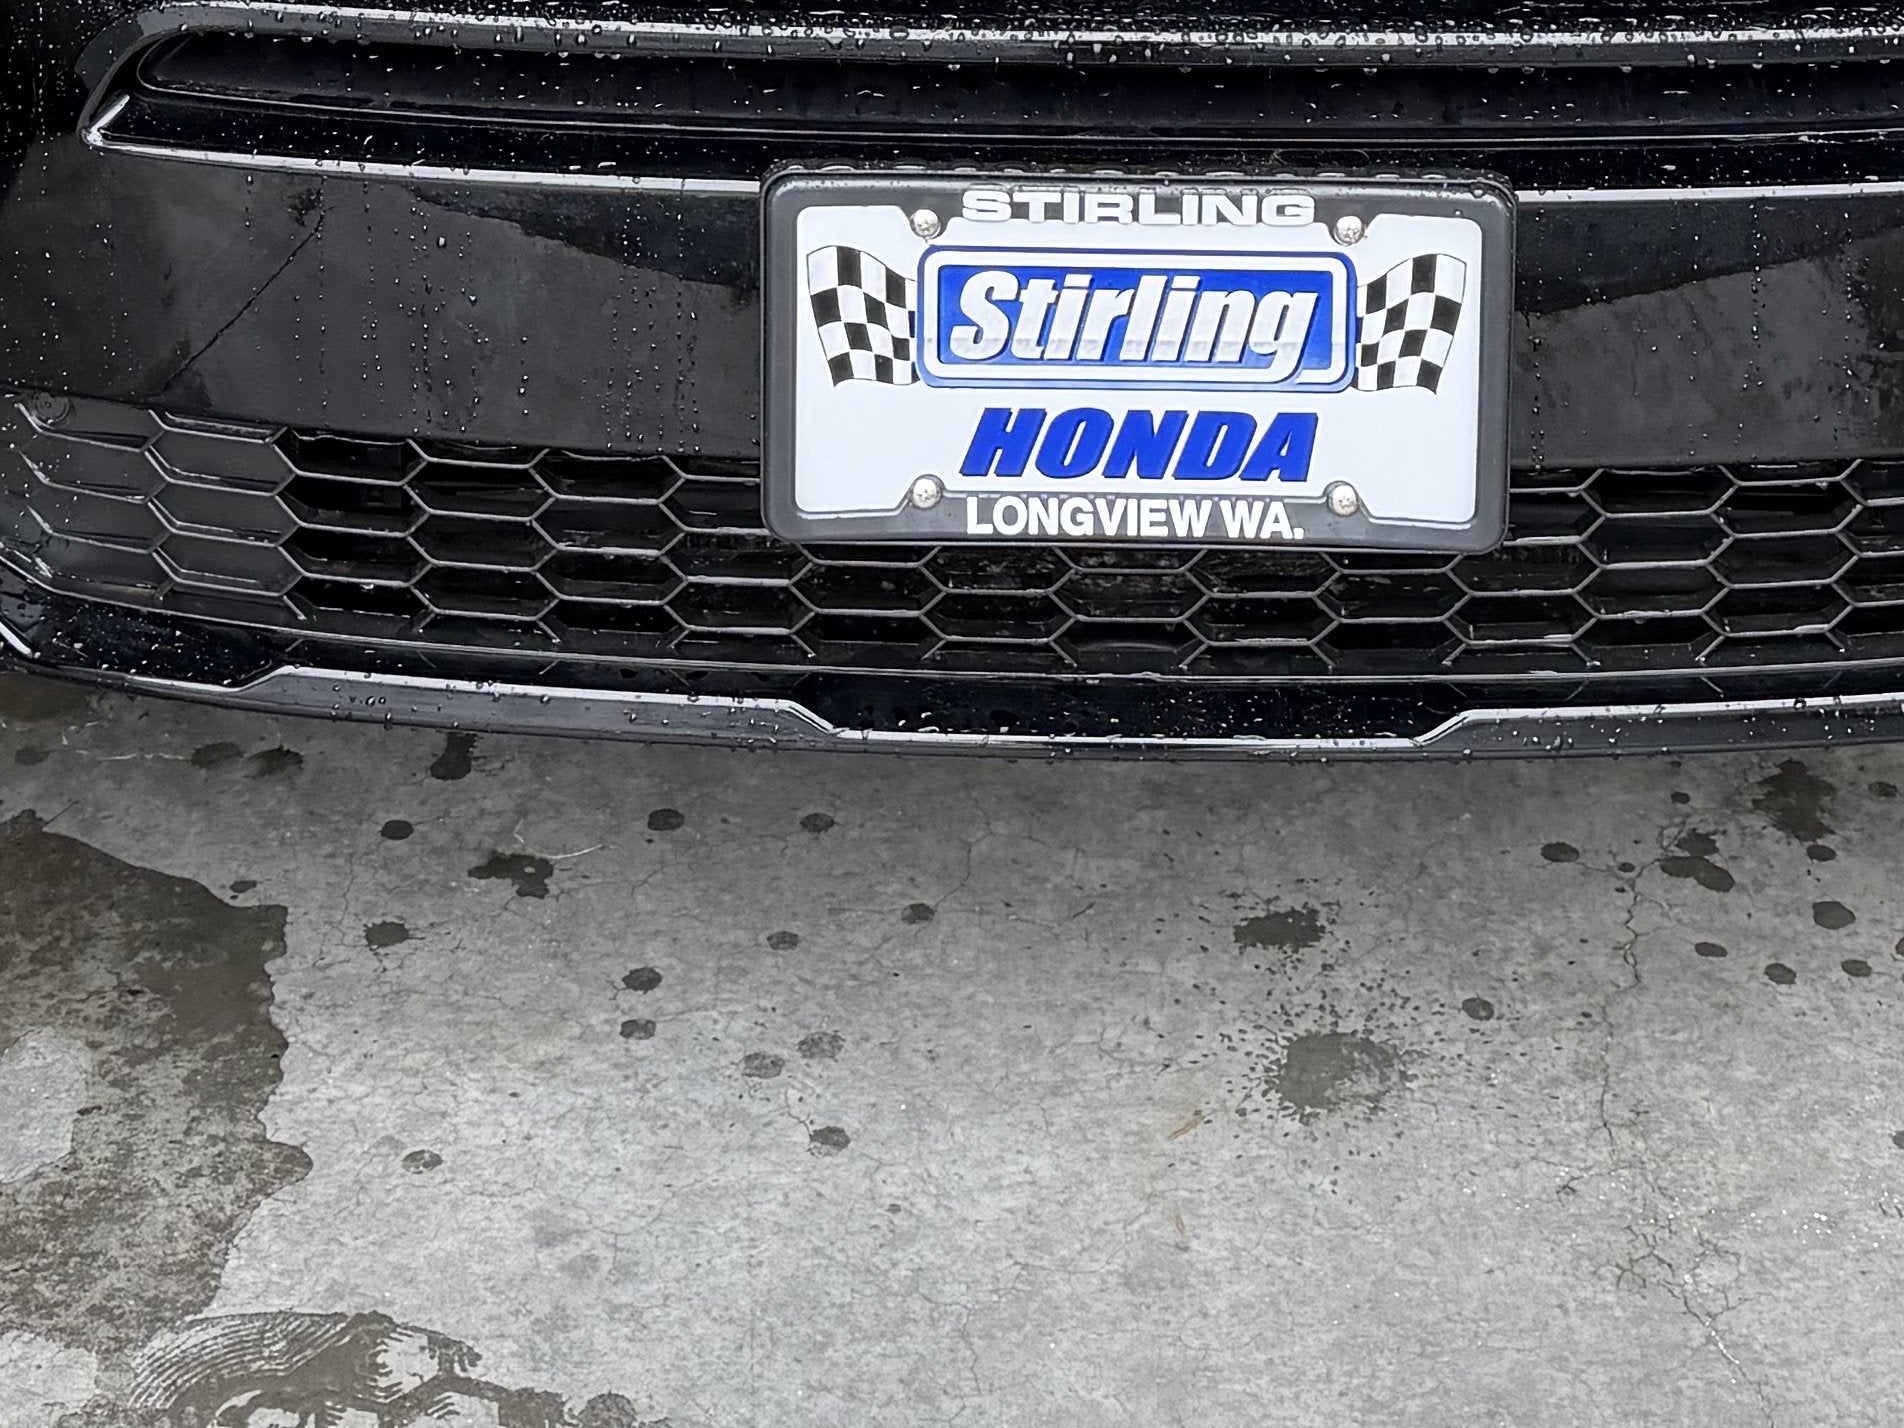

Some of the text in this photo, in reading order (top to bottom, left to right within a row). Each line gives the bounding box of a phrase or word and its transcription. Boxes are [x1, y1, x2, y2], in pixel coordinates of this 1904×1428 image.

[961, 189, 1315, 226] STIRLING
[949, 269, 1320, 383] Stirling
[959, 407, 1319, 482] HONDA
[966, 496, 1304, 540] LONGVIEW WA.
